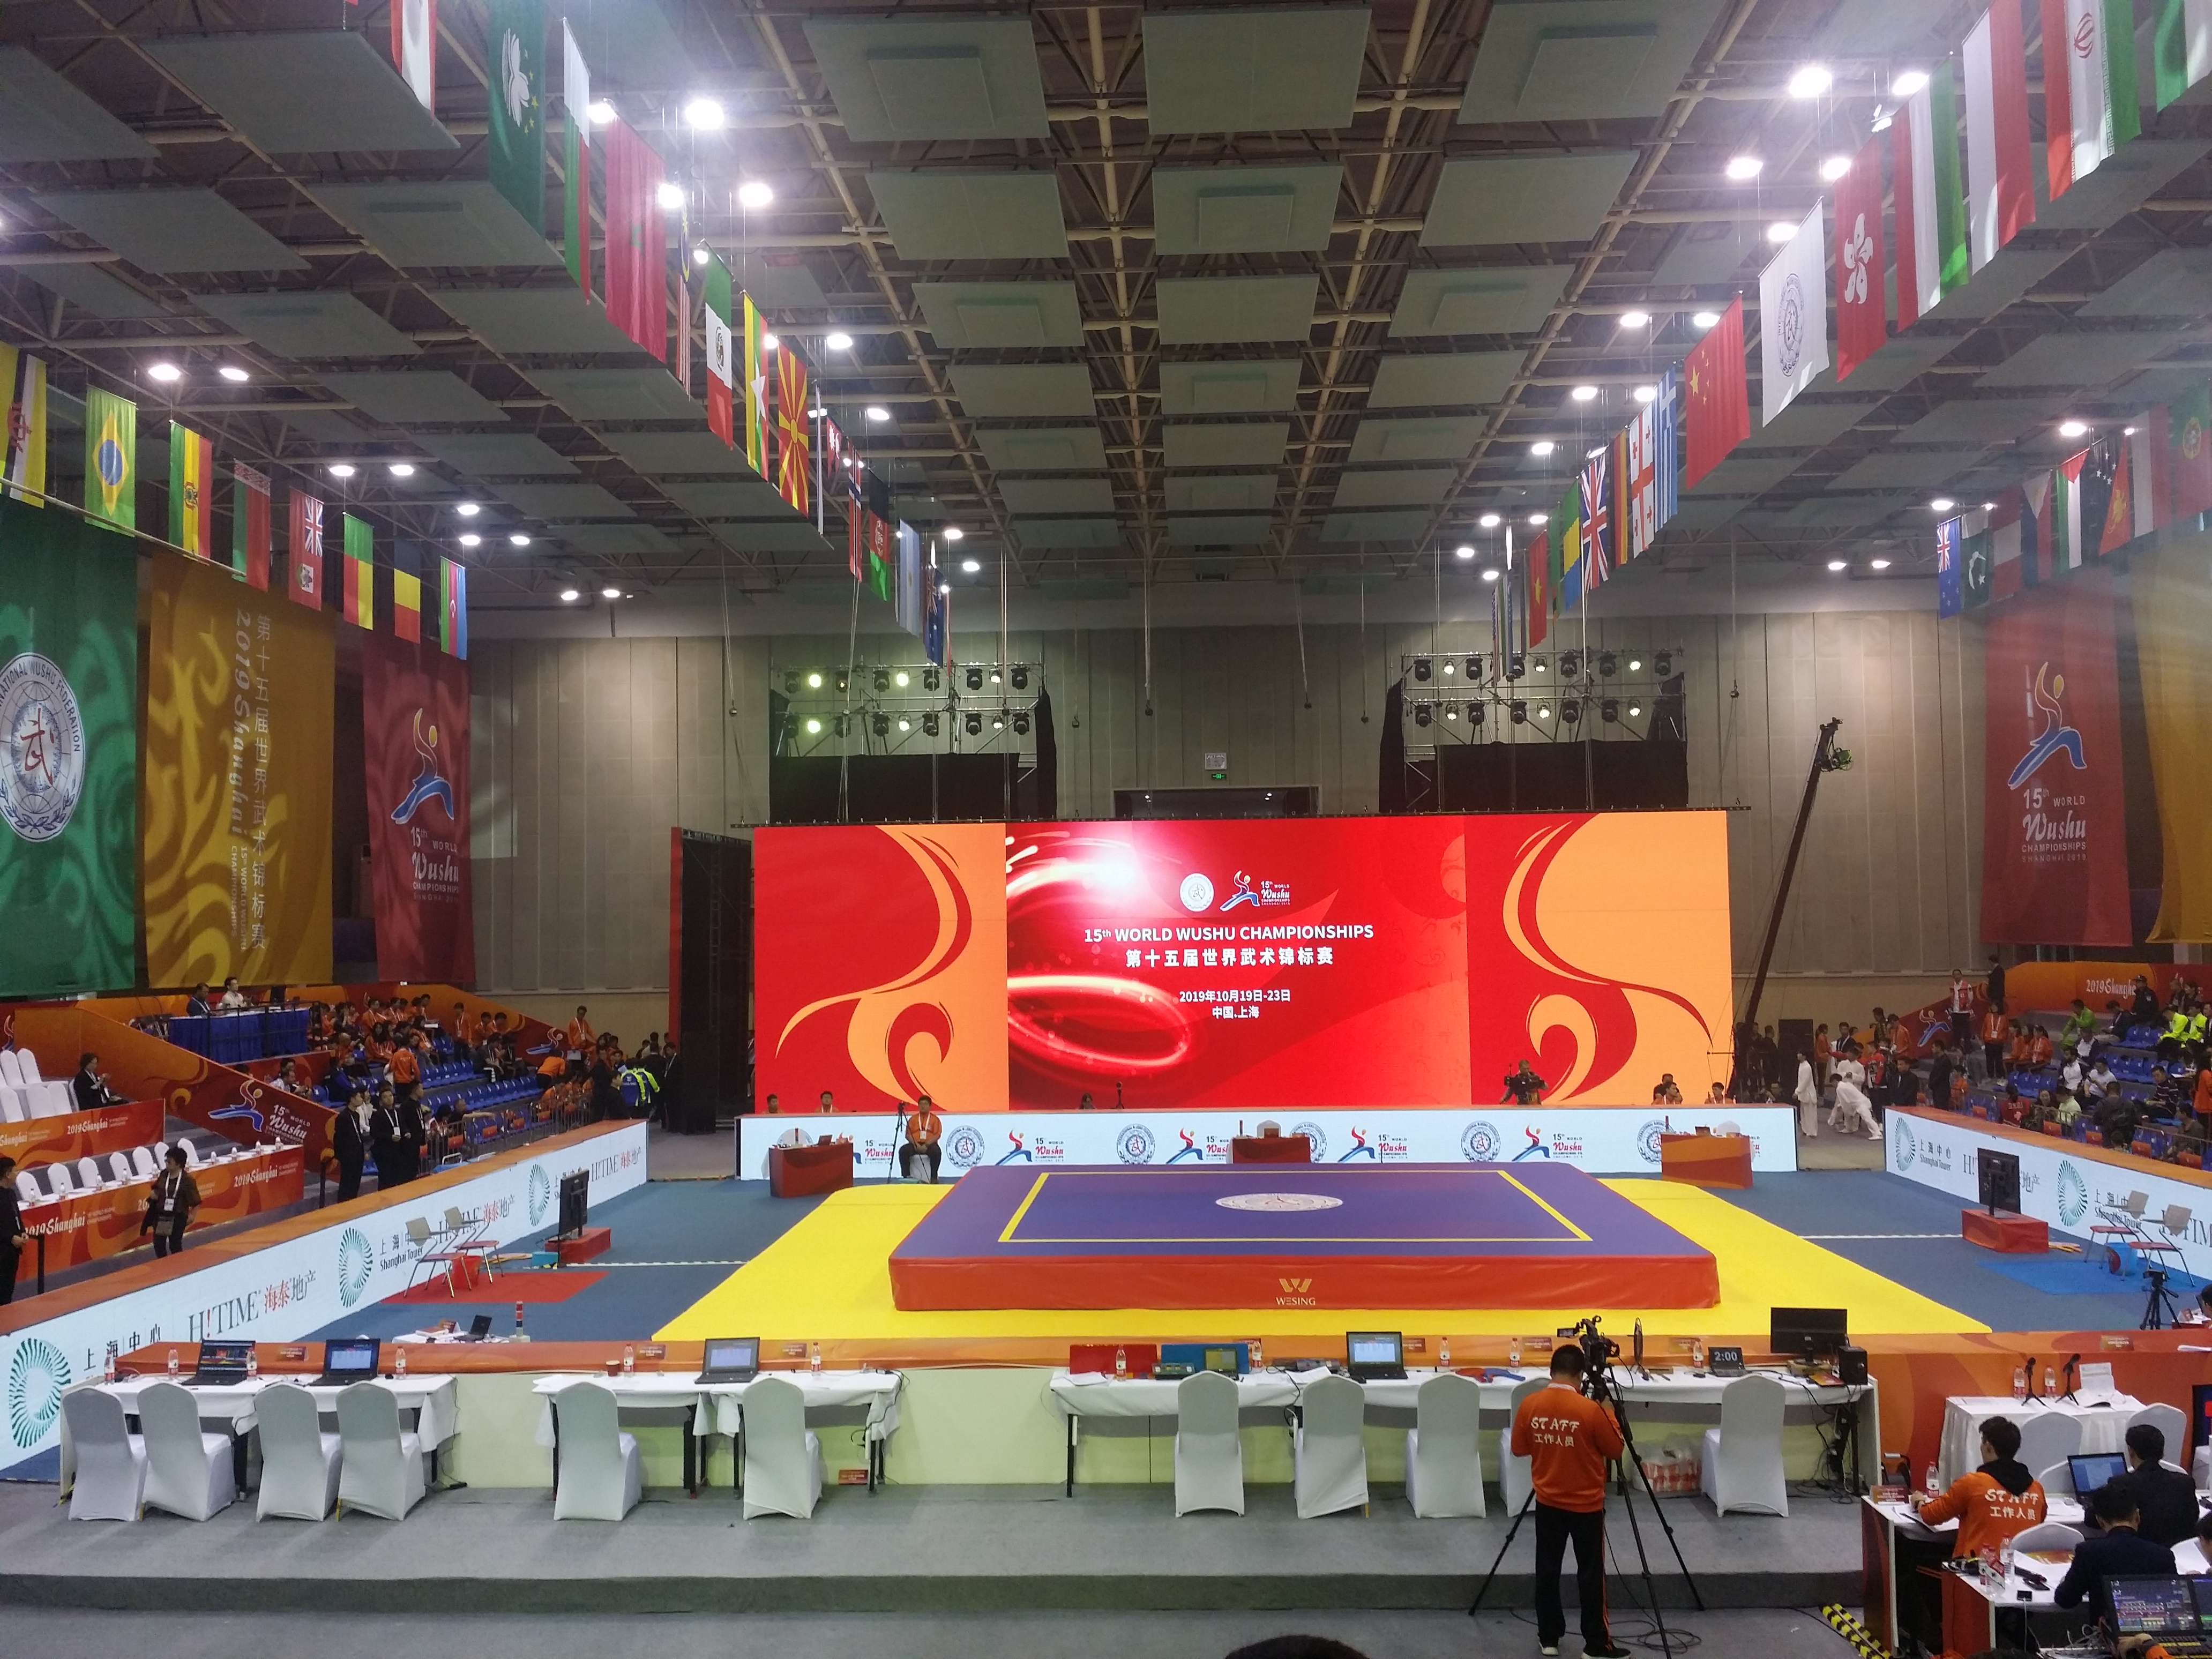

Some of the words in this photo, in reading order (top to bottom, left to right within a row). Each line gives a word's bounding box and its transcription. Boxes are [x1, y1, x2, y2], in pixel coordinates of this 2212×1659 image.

[28, 660, 56, 685] WUSHU
[56, 679, 81, 752] FEDERATION
[252, 614, 271, 949] 第十五届世界武术锦标赛
[2053, 795, 2086, 808] WORLD
[2022, 810, 2086, 842] Wushu
[410, 826, 428, 848] 15th
[2021, 841, 2086, 853] CHAMPIONSHIPS
[411, 851, 459, 883] Wushu
[413, 881, 459, 893] CHAMPIONSHIPS
[1261, 888, 1290, 899] Wushu
[1084, 929, 1111, 943] 15th
[1115, 928, 1172, 942] WORLD
[1176, 927, 1236, 941] WUSHU
[1239, 924, 1374, 940] CHAMPIONSHIPS
[1125, 946, 1333, 968] 第十五届世界武术锦标赛
[1179, 989, 1290, 1003] 2019年10月19日-23日
[269, 1114, 308, 1140] Wushu
[1035, 1145, 1064, 1155] Wushu
[1378, 1142, 1407, 1152] Wushu
[1553, 1141, 1582, 1152] Wushu
[1919, 1154, 1938, 1168] Shanghai
[1939, 1159, 1952, 1171] Tower
[380, 1252, 407, 1272] Shanghai
[407, 1246, 423, 1259] Tower
[264, 1269, 316, 1314] 海泰地产
[1276, 1297, 1316, 1306] WESING
[1714, 1351, 1738, 1361] 2:00
[1530, 1417, 1580, 1433] STAFF
[1534, 1433, 1575, 1447] 工作人员
[1984, 1488, 2039, 1506] STAFF
[1989, 1506, 2036, 1521] 工作人员
